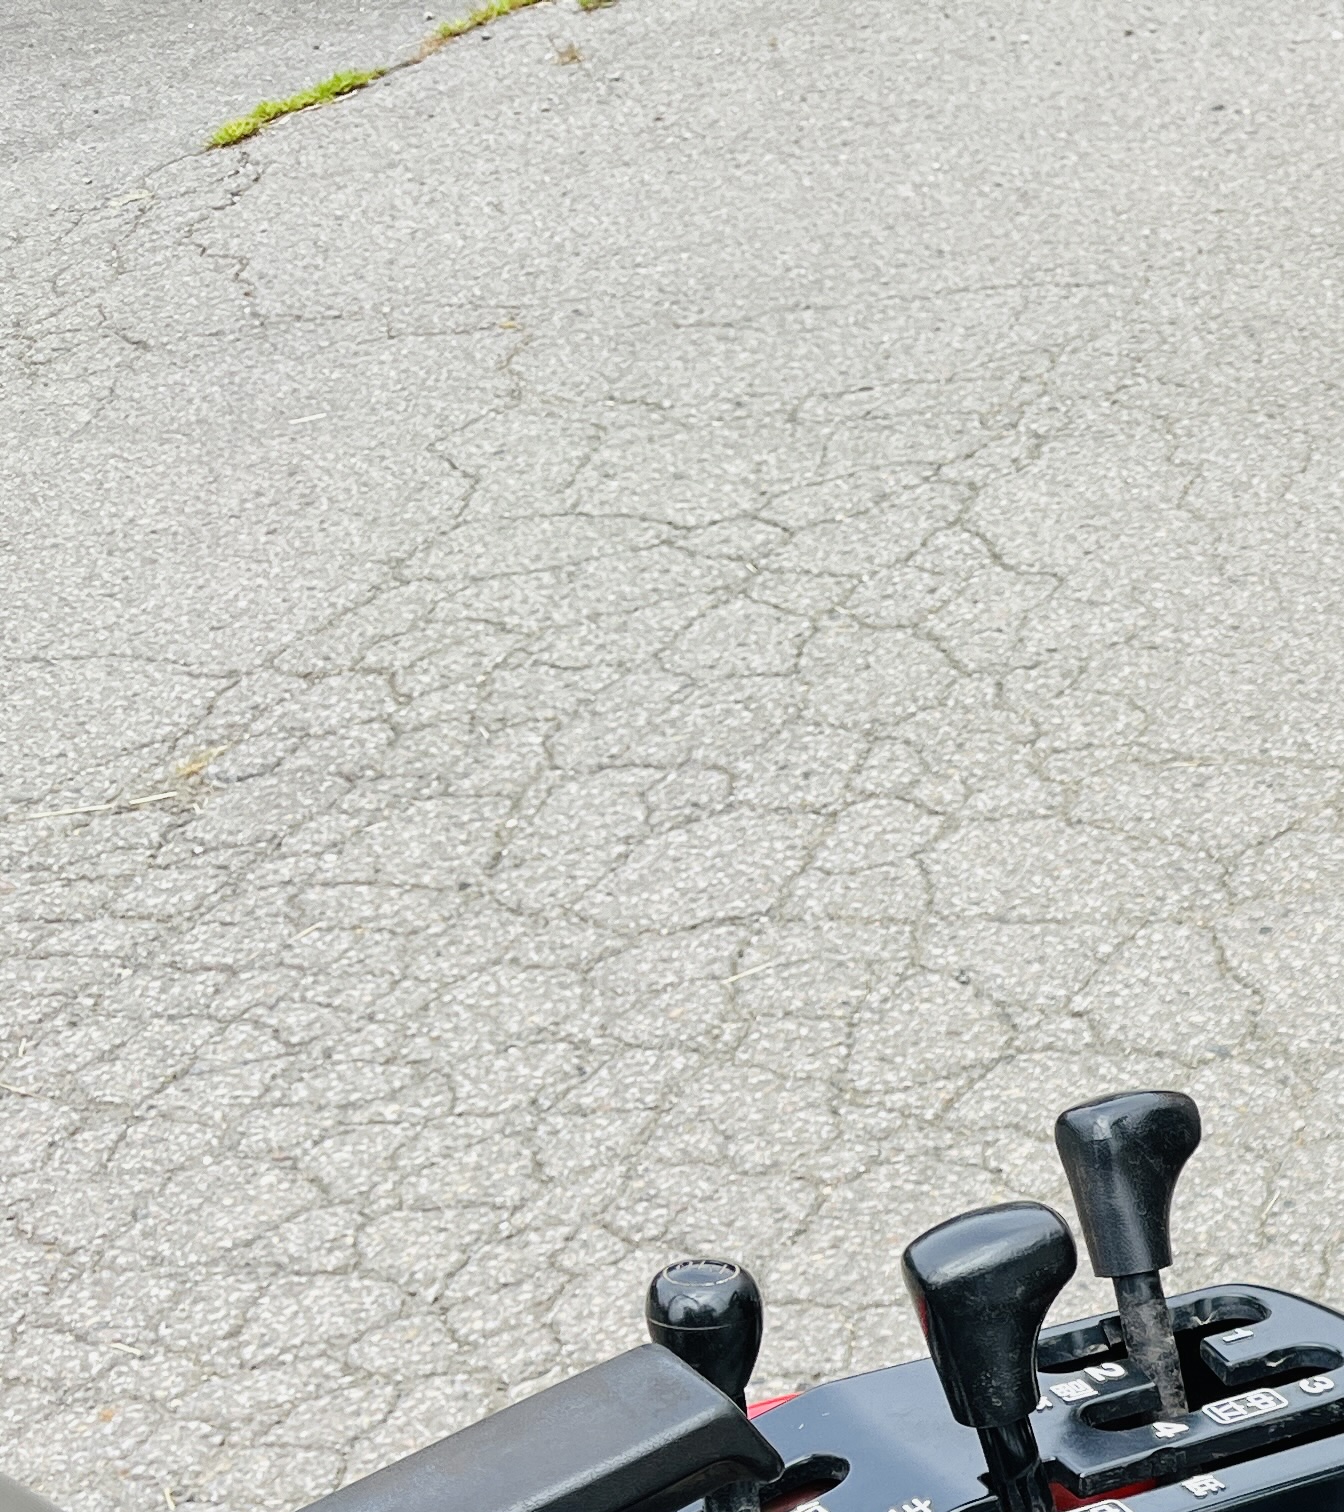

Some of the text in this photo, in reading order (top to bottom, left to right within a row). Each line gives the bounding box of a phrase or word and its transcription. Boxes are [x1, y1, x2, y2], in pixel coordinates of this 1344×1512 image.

[1222, 1327, 1255, 1343] 1
[1084, 1361, 1127, 1382] 2
[1299, 1375, 1335, 1395] 3
[1208, 1392, 1283, 1422] 中立
[1152, 1420, 1190, 1439] 4
